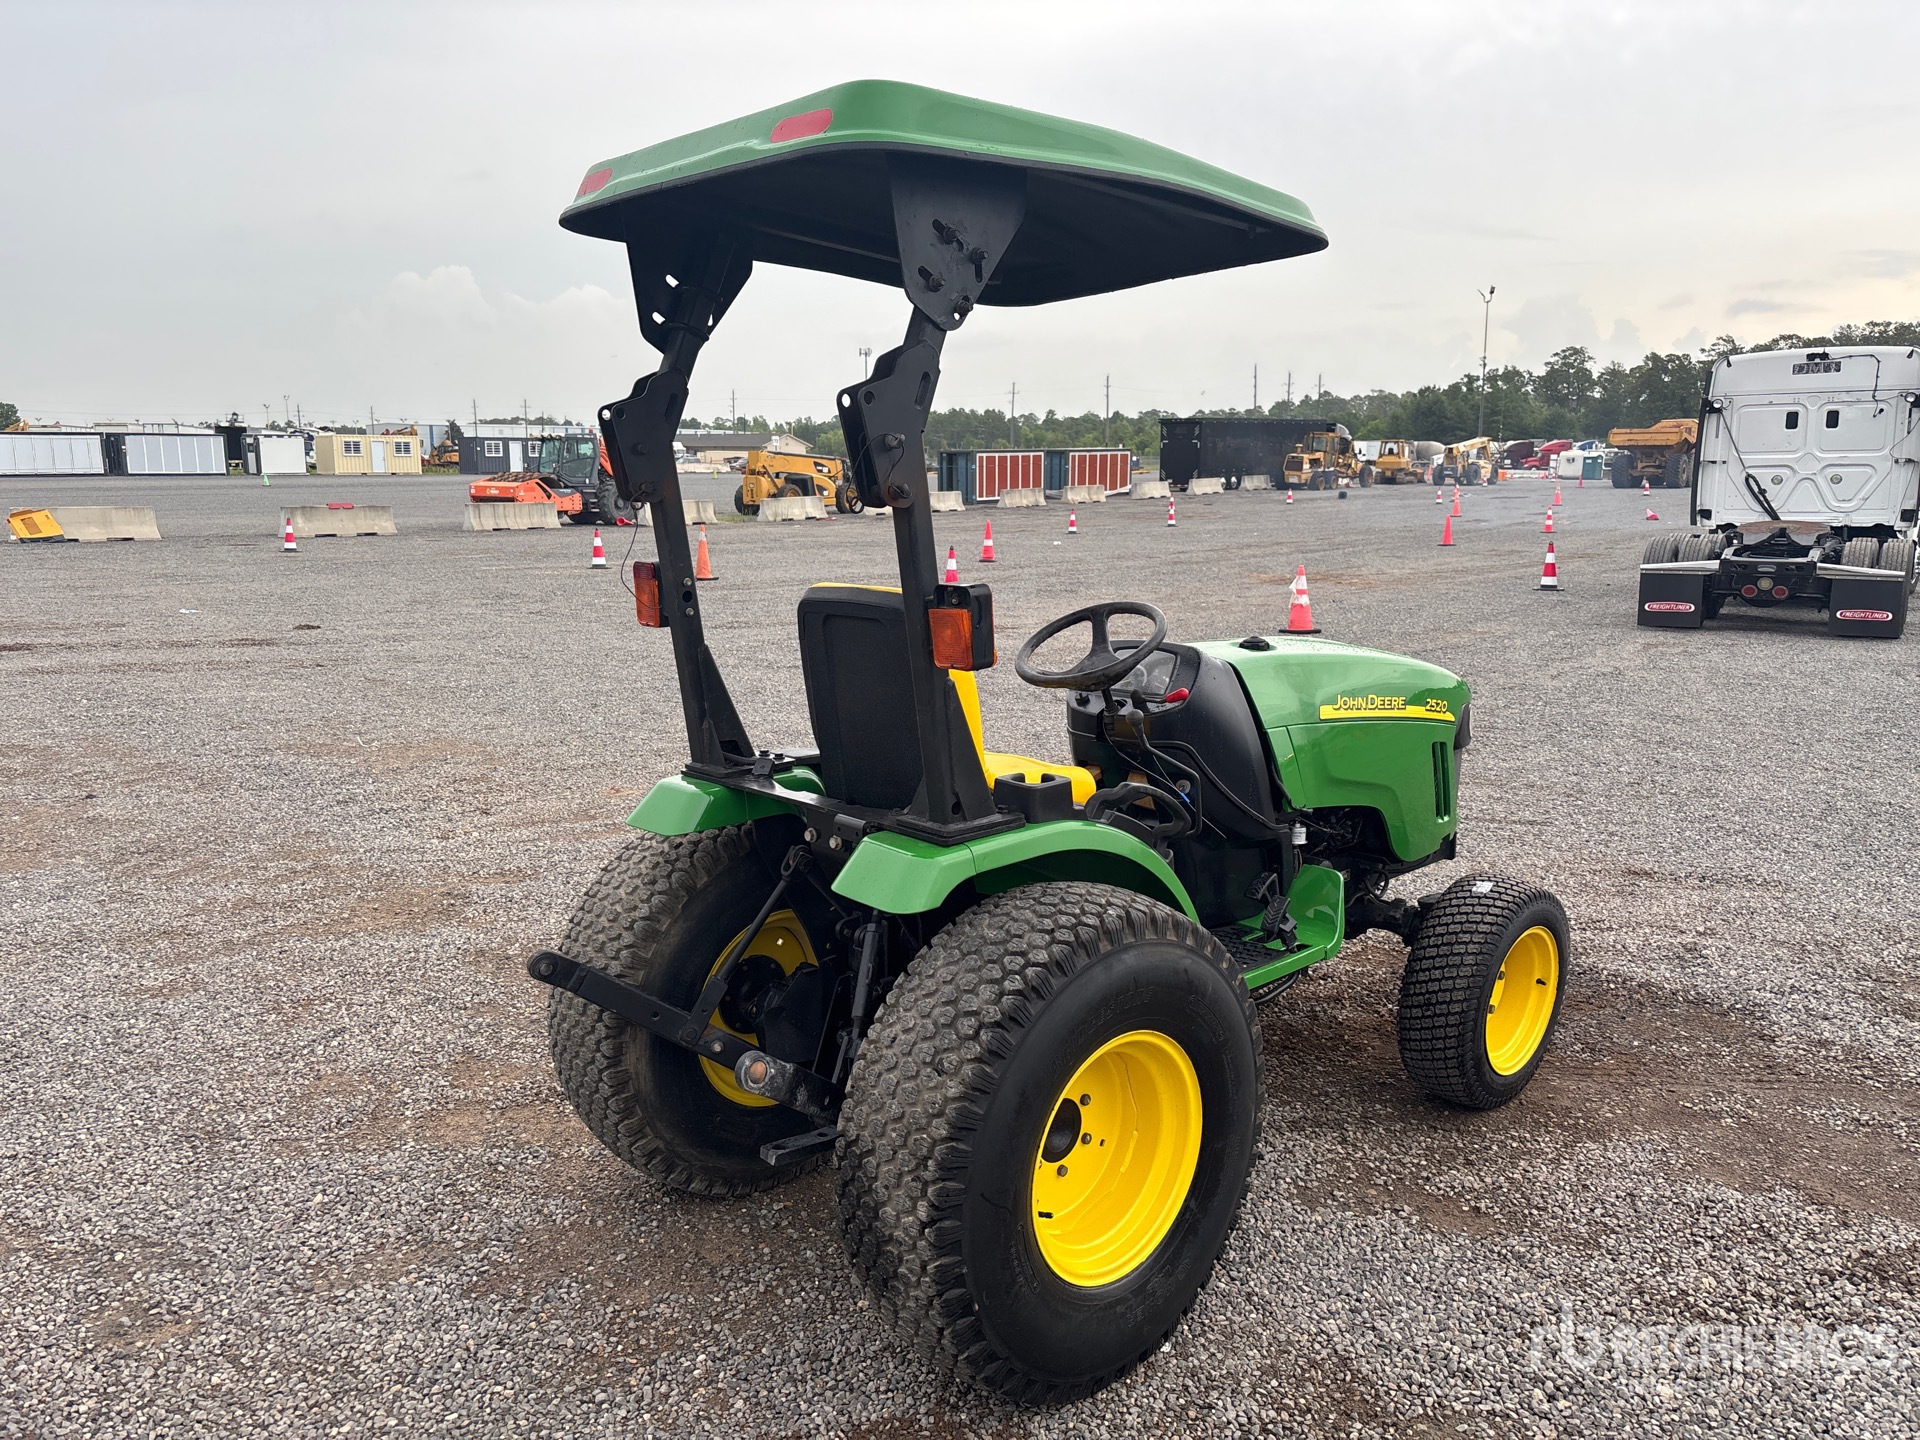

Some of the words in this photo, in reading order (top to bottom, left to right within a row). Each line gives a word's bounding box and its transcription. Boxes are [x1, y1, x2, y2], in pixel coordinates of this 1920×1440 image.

[1841, 611, 1888, 619] FREIGHTLINER
[1333, 694, 1366, 710] JOHN
[1368, 694, 1407, 711] DEERE
[1425, 698, 1448, 713] 2520
